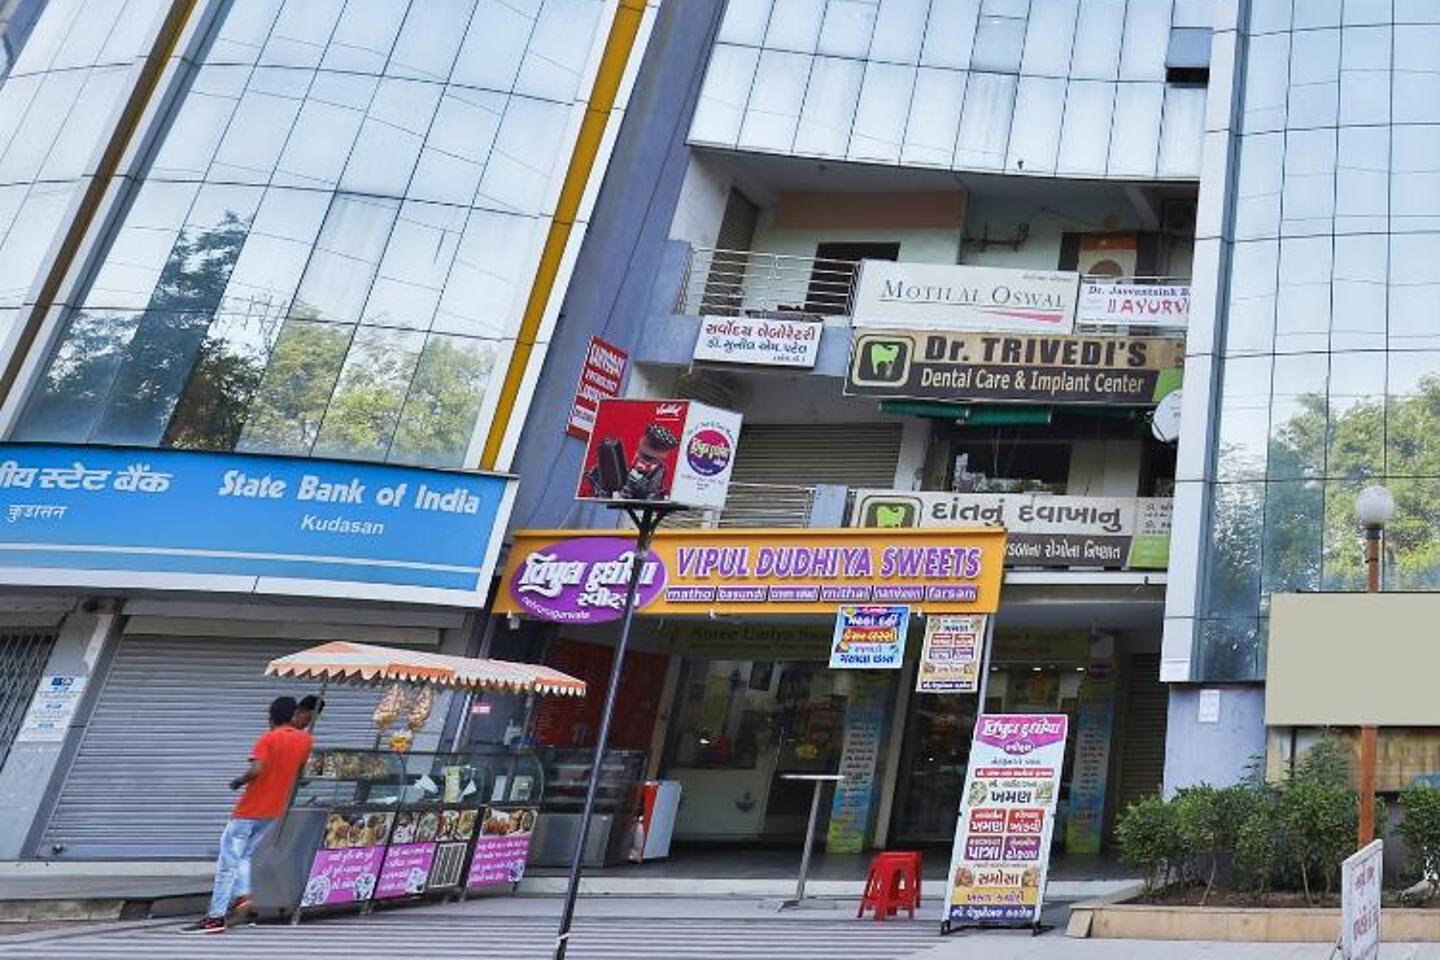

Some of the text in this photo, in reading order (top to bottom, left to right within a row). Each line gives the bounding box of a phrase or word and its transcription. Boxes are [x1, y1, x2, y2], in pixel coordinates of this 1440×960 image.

[991, 286, 1066, 308] OSWAL
[924, 336, 1148, 368] Dr. TRIVEDI'S
[921, 367, 1145, 397] Dental Care & Implant Center
[218, 469, 480, 515] State Bank of India
[300, 513, 385, 535] Kudasan
[676, 546, 982, 578] VIPUL DUDHIYA SWEETS
